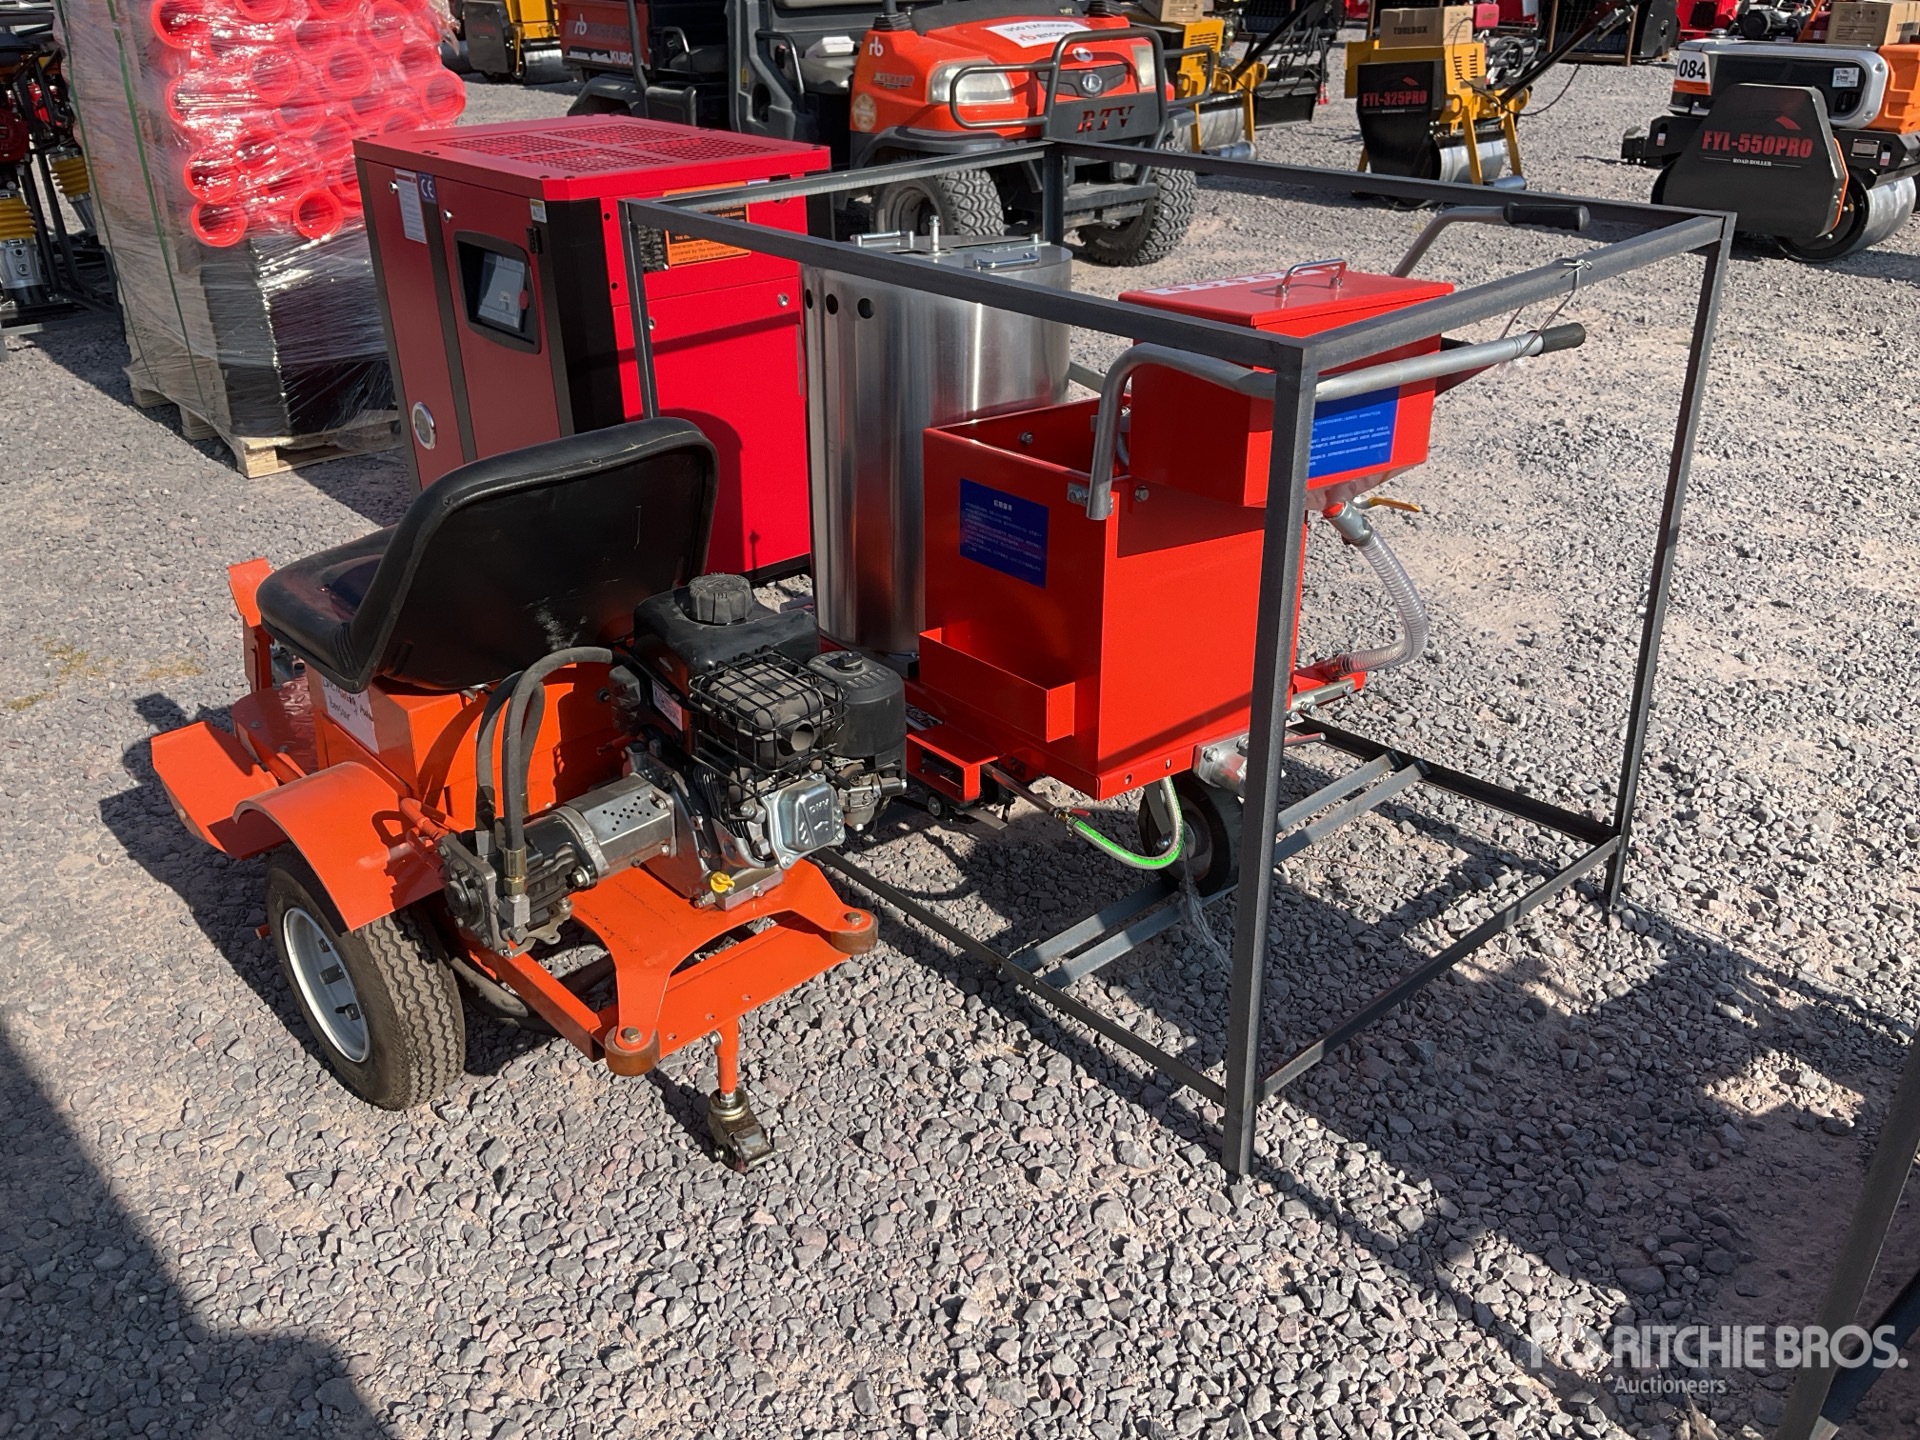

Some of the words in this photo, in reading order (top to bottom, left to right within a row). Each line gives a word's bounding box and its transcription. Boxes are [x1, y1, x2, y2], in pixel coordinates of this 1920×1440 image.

[1393, 25, 1428, 35] TOOLBOX
[868, 36, 884, 57] rb
[1679, 59, 1707, 79] 084
[1362, 90, 1428, 107] FYL-325PRO
[1075, 105, 1135, 133] RTV
[1701, 130, 1814, 158] FYL-550PRO
[1749, 159, 1772, 167] ROLLER
